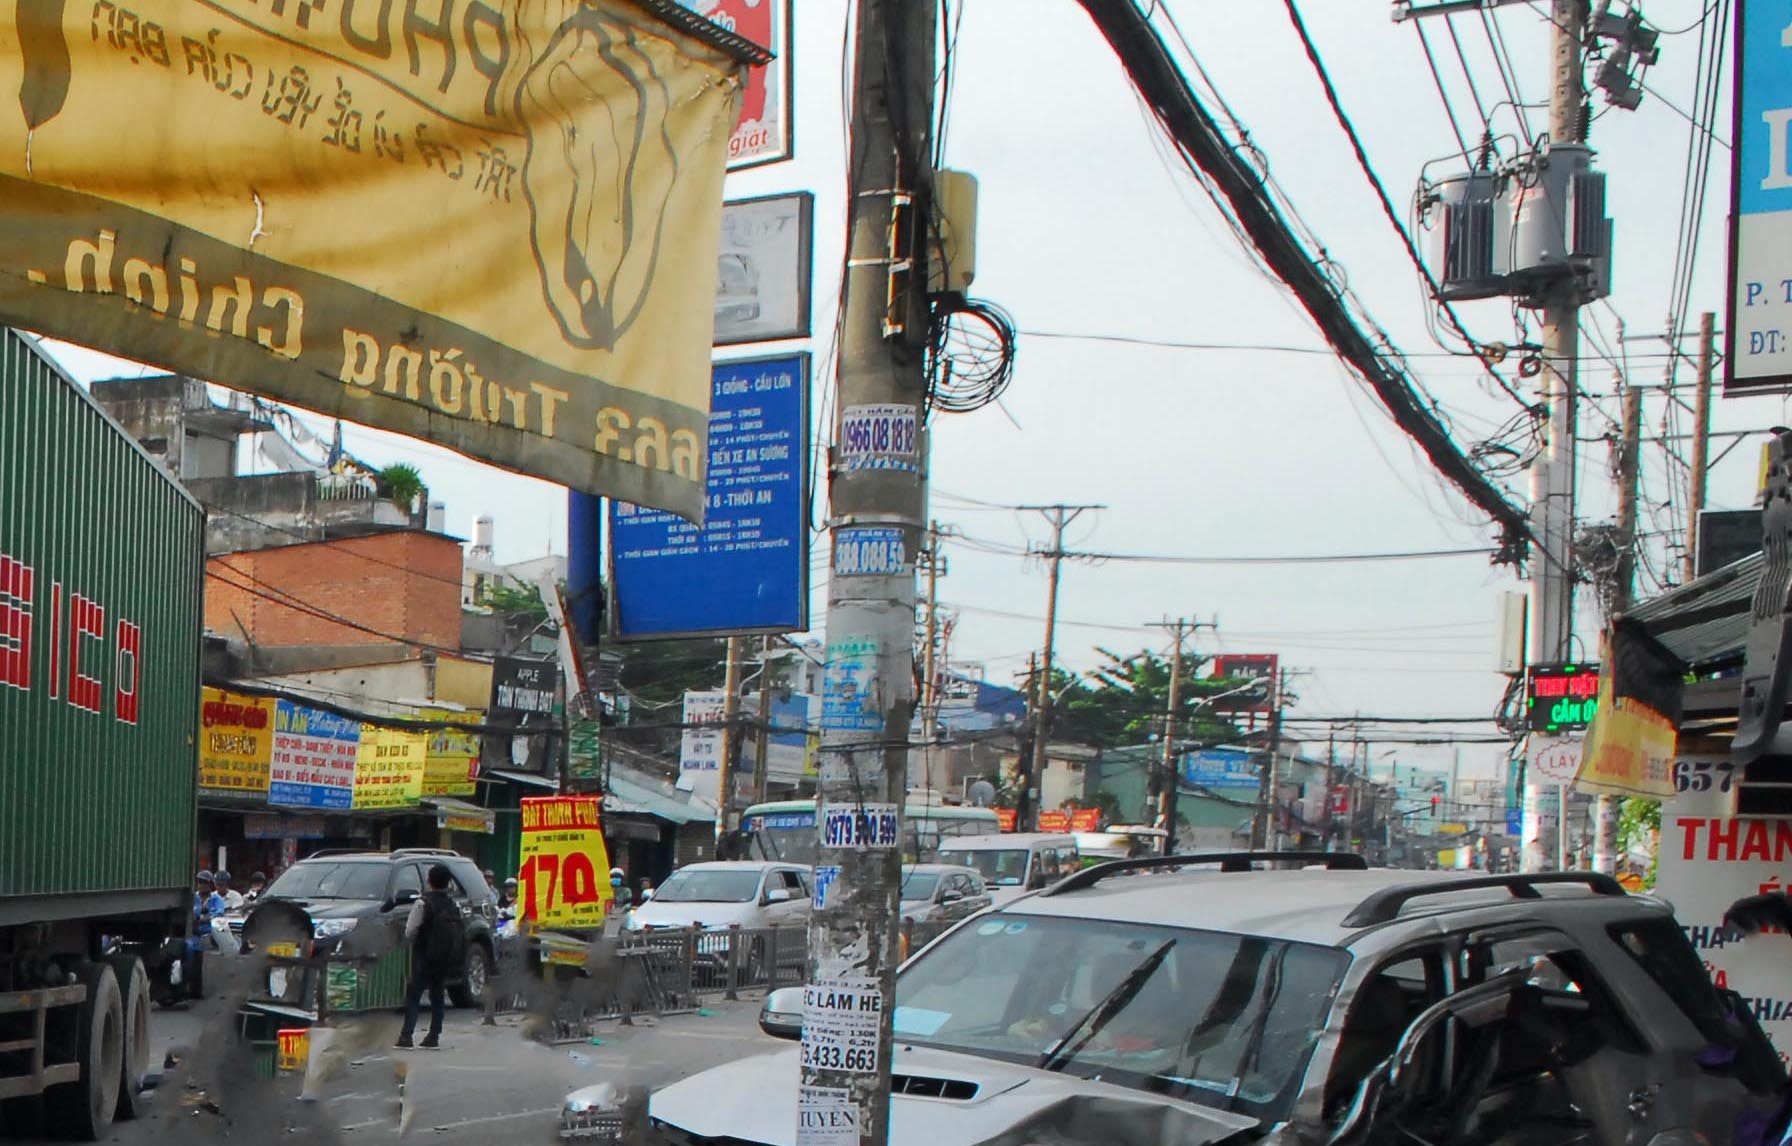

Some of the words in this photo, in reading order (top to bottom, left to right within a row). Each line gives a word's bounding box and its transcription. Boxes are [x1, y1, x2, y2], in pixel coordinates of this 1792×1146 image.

[1749, 329, 1785, 355] ĐT:
[732, 449, 743, 464] XE
[746, 446, 757, 462] AN
[758, 491, 771, 505] AN
